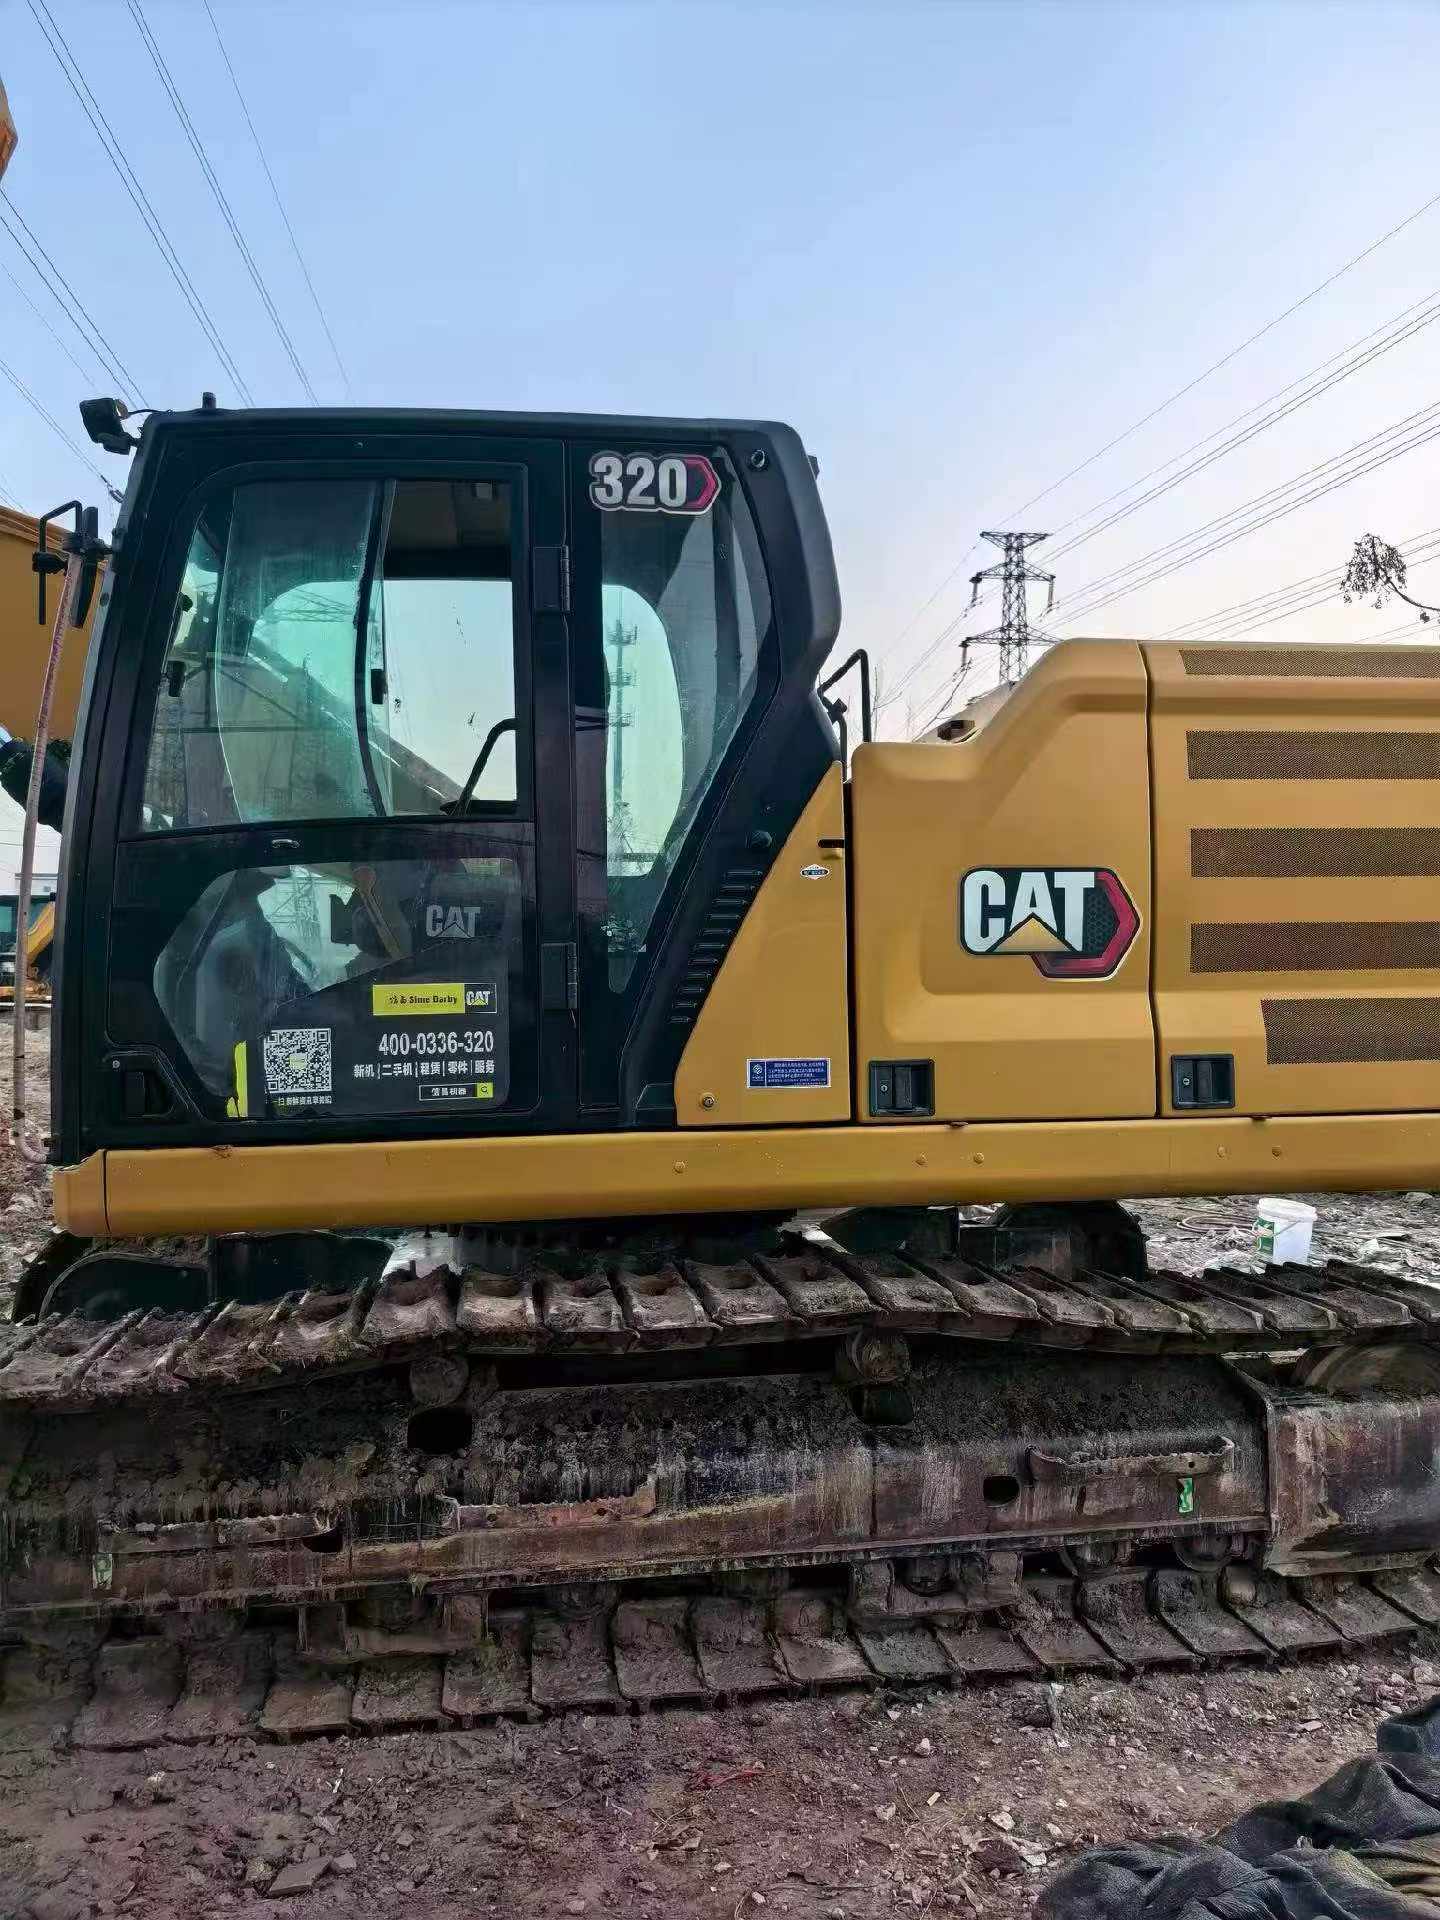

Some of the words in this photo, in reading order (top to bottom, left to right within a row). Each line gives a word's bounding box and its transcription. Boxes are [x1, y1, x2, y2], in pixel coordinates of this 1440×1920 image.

[594, 456, 687, 507] 320
[425, 904, 481, 938] CAT
[963, 870, 1095, 952] CAT
[465, 991, 491, 1006] CAT
[378, 1031, 494, 1055] 400-0336-320
